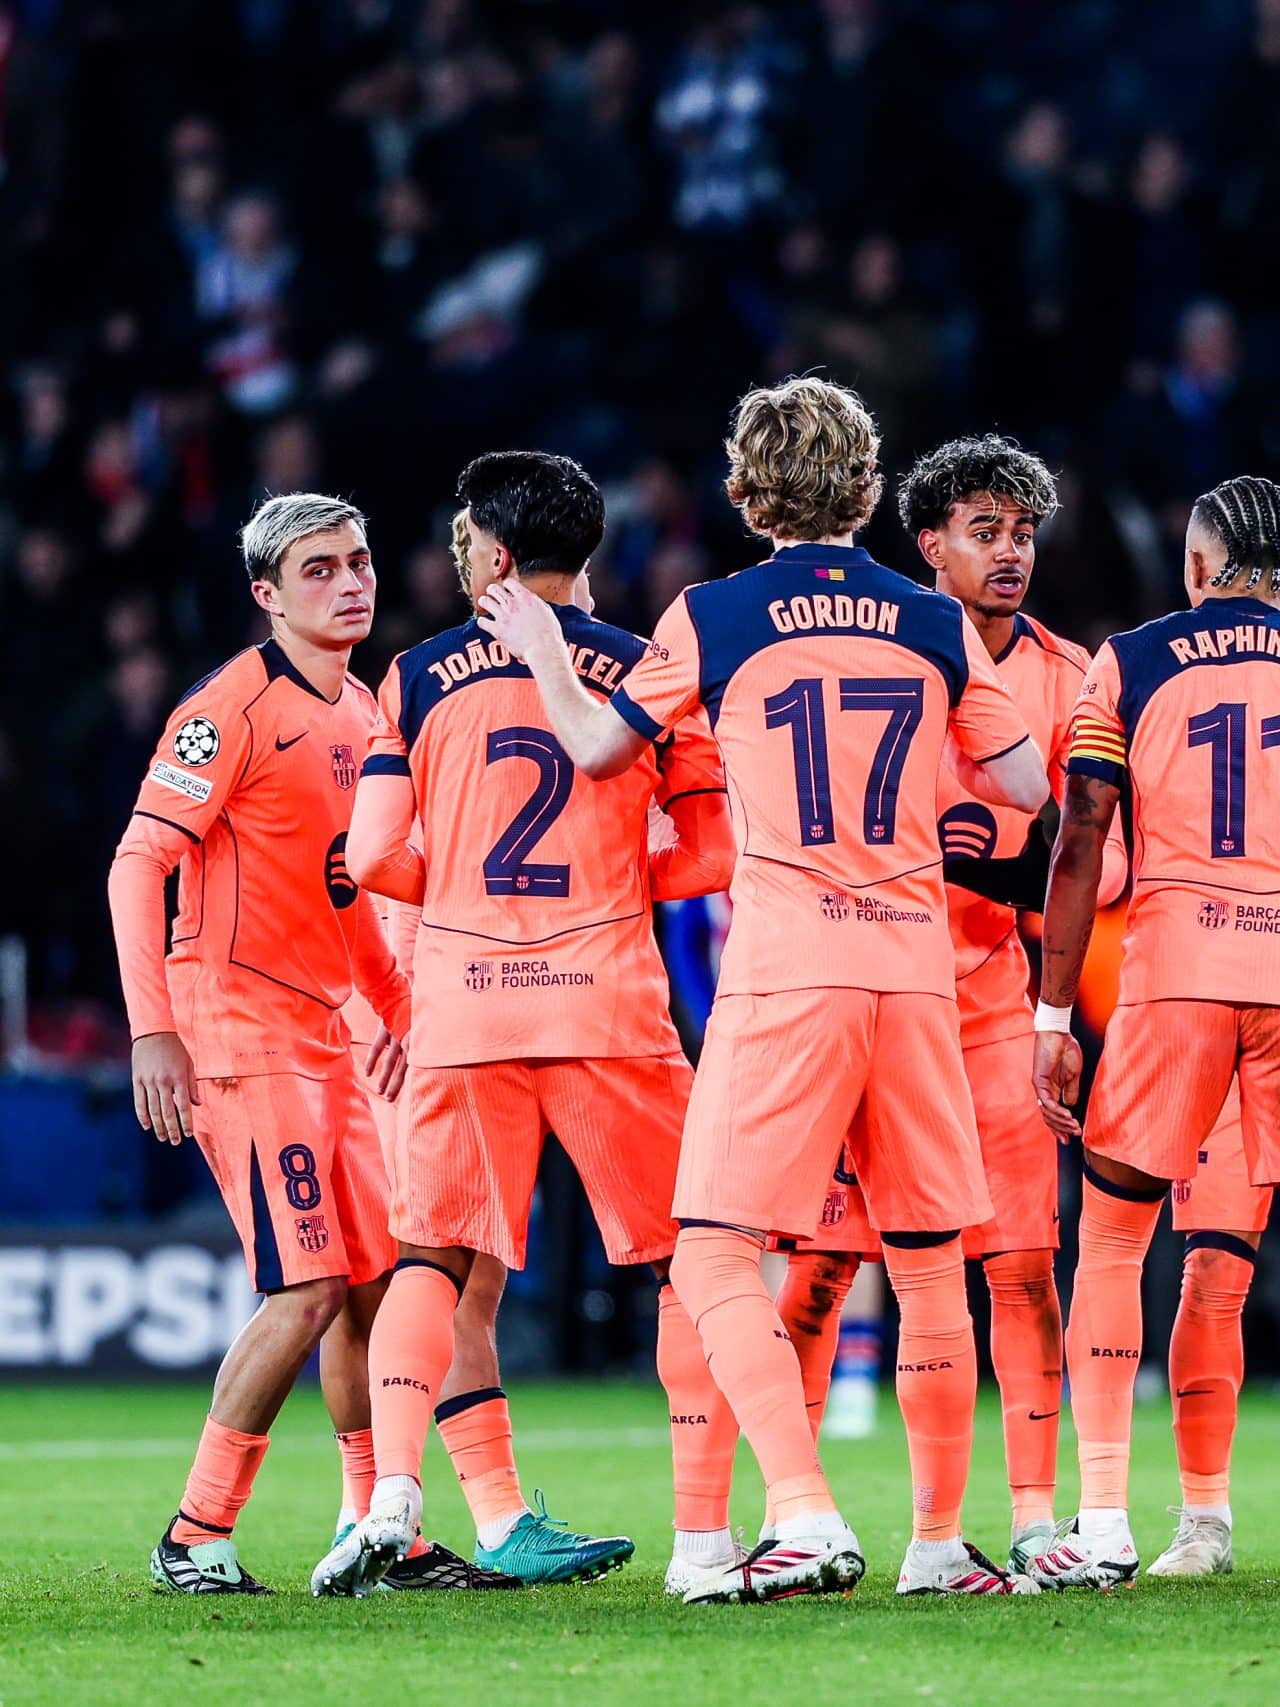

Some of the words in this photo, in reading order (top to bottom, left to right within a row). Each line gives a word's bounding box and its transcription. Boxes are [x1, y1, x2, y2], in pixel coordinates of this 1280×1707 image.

[768, 594, 900, 636] GORDON
[428, 638, 512, 692] JOÃO
[764, 678, 924, 846] 17
[483, 727, 575, 897] 2
[855, 897, 894, 909] BAR
[856, 909, 933, 923] FOUNDATION
[501, 961, 549, 975] BARÇA
[501, 973, 594, 988] FOUNDATION
[278, 1143, 322, 1211] 8
[1091, 1347, 1139, 1359] BARÇA
[670, 1414, 708, 1425] ARÇA
